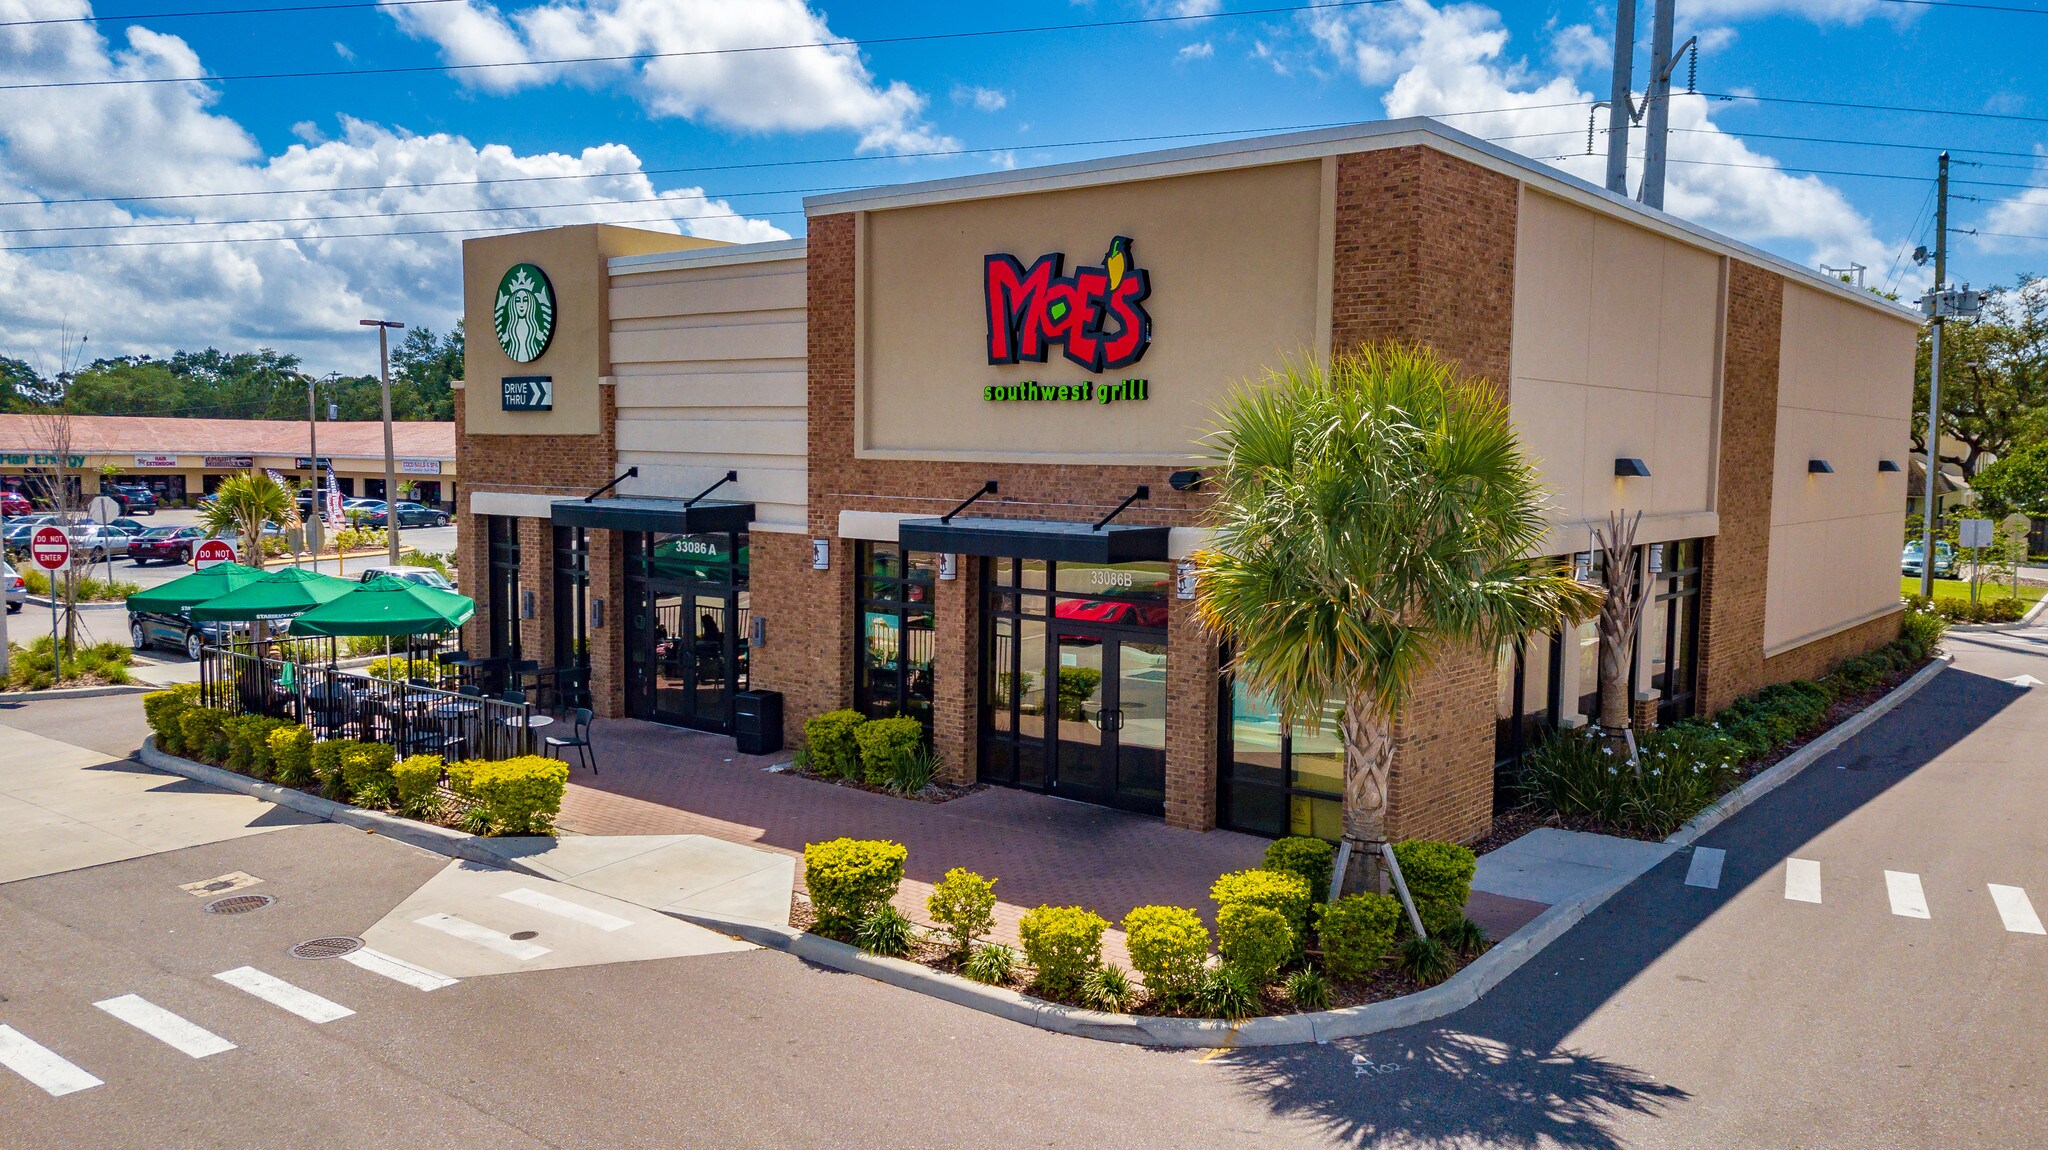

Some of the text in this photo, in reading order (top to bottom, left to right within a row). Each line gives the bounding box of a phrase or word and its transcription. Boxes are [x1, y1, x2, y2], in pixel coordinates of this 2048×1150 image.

[504, 383, 528, 394] DRIVE
[984, 379, 1148, 404] southwest grill
[504, 394, 526, 406] THRU
[676, 541, 716, 555] 33086 A
[1091, 571, 1132, 586] 33086B
